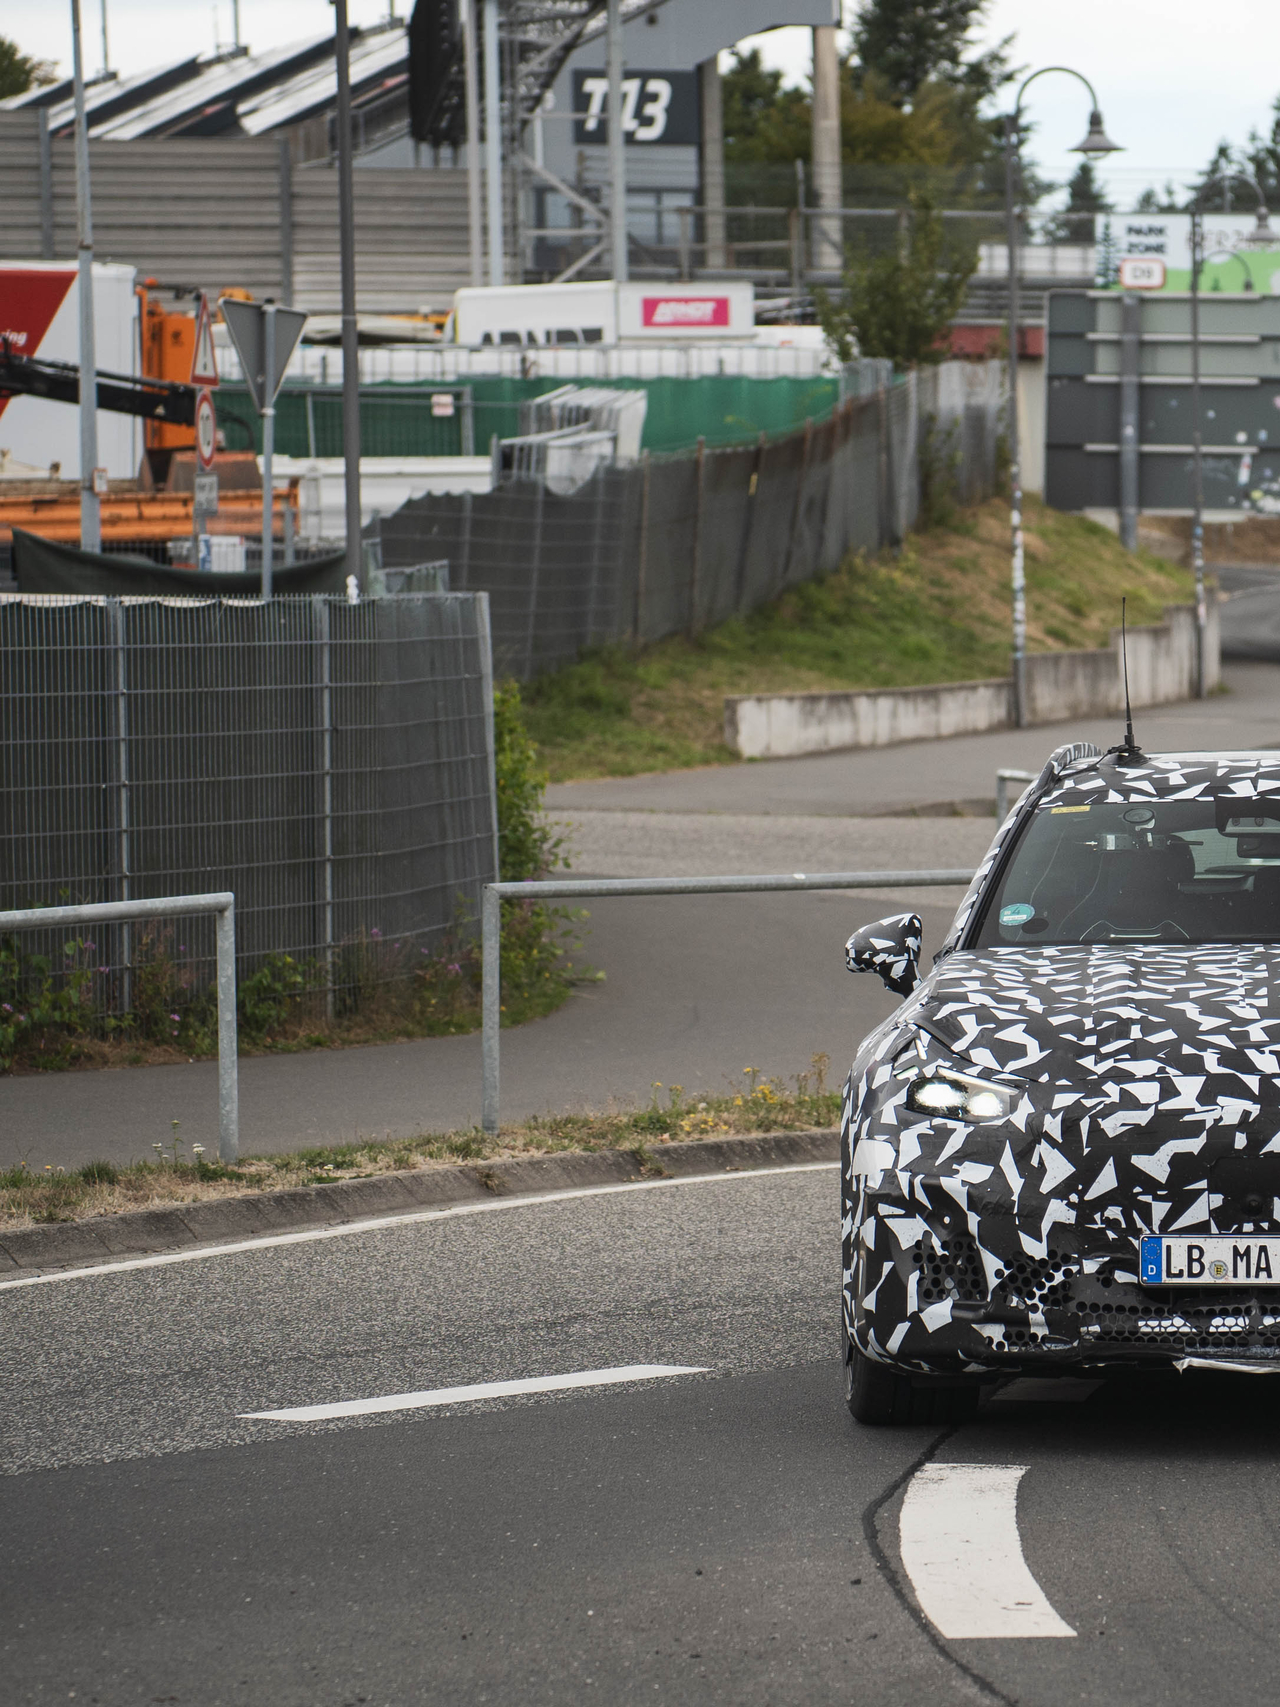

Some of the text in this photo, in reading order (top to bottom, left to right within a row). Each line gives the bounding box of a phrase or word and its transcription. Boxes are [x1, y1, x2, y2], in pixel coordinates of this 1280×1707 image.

[581, 77, 672, 141] T13
[1126, 225, 1166, 236] PARK
[1126, 242, 1166, 254] ZONE
[1165, 1244, 1206, 1279] LB
[1232, 1244, 1273, 1279] MA
[1148, 1264, 1157, 1275] D
